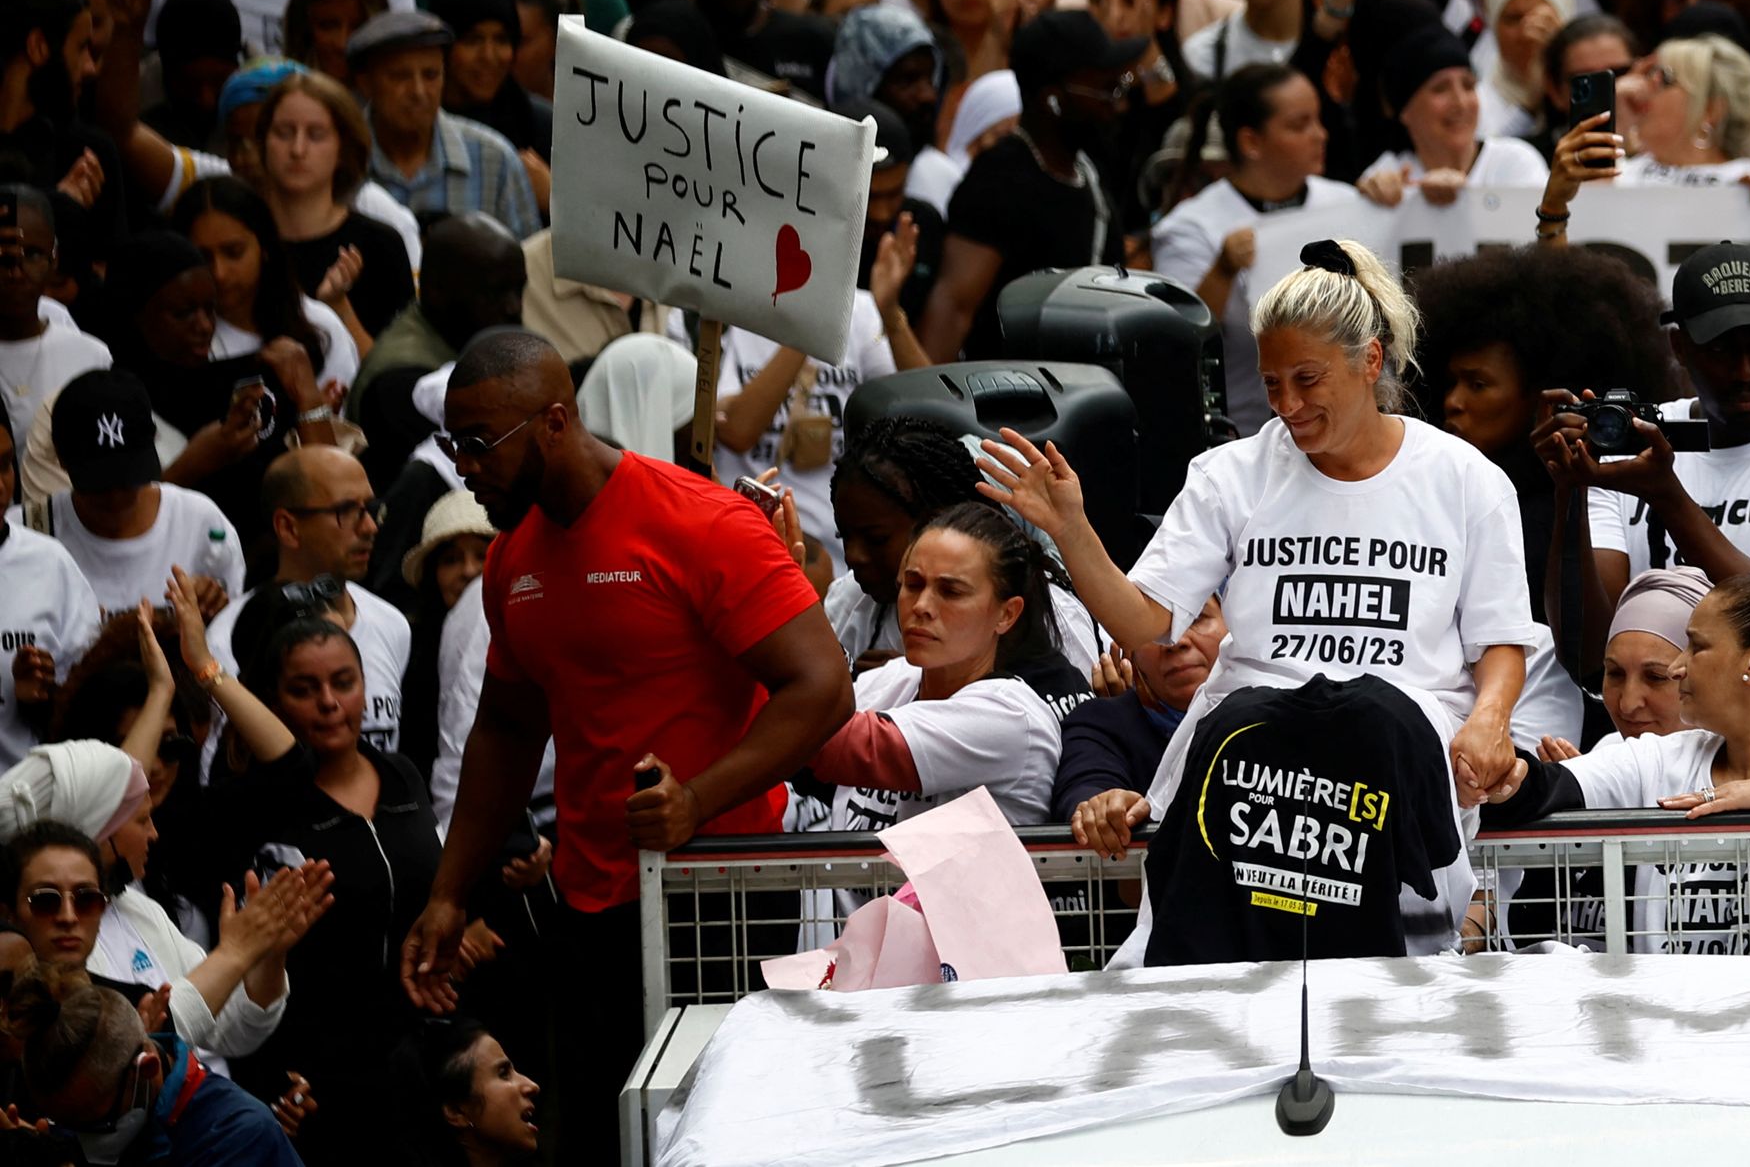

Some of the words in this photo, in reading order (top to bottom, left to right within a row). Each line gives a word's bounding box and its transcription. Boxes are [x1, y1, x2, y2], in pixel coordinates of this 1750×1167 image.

[573, 65, 817, 217] JUSTICE
[643, 163, 746, 226] POUR
[612, 211, 733, 290] NAËL
[586, 570, 642, 584] MEDIATEUR
[1243, 536, 1360, 567] JUSTICE
[1368, 539, 1448, 577] POUR
[1279, 581, 1401, 622] NAHEL
[1270, 633, 1405, 666] 27/06/23
[1249, 792, 1275, 806] POUR
[1229, 801, 1369, 874] SABRI
[1273, 897, 1280, 905] le
[1280, 874, 1297, 890] LA
[1301, 878, 1350, 900] VÉRITÉ
